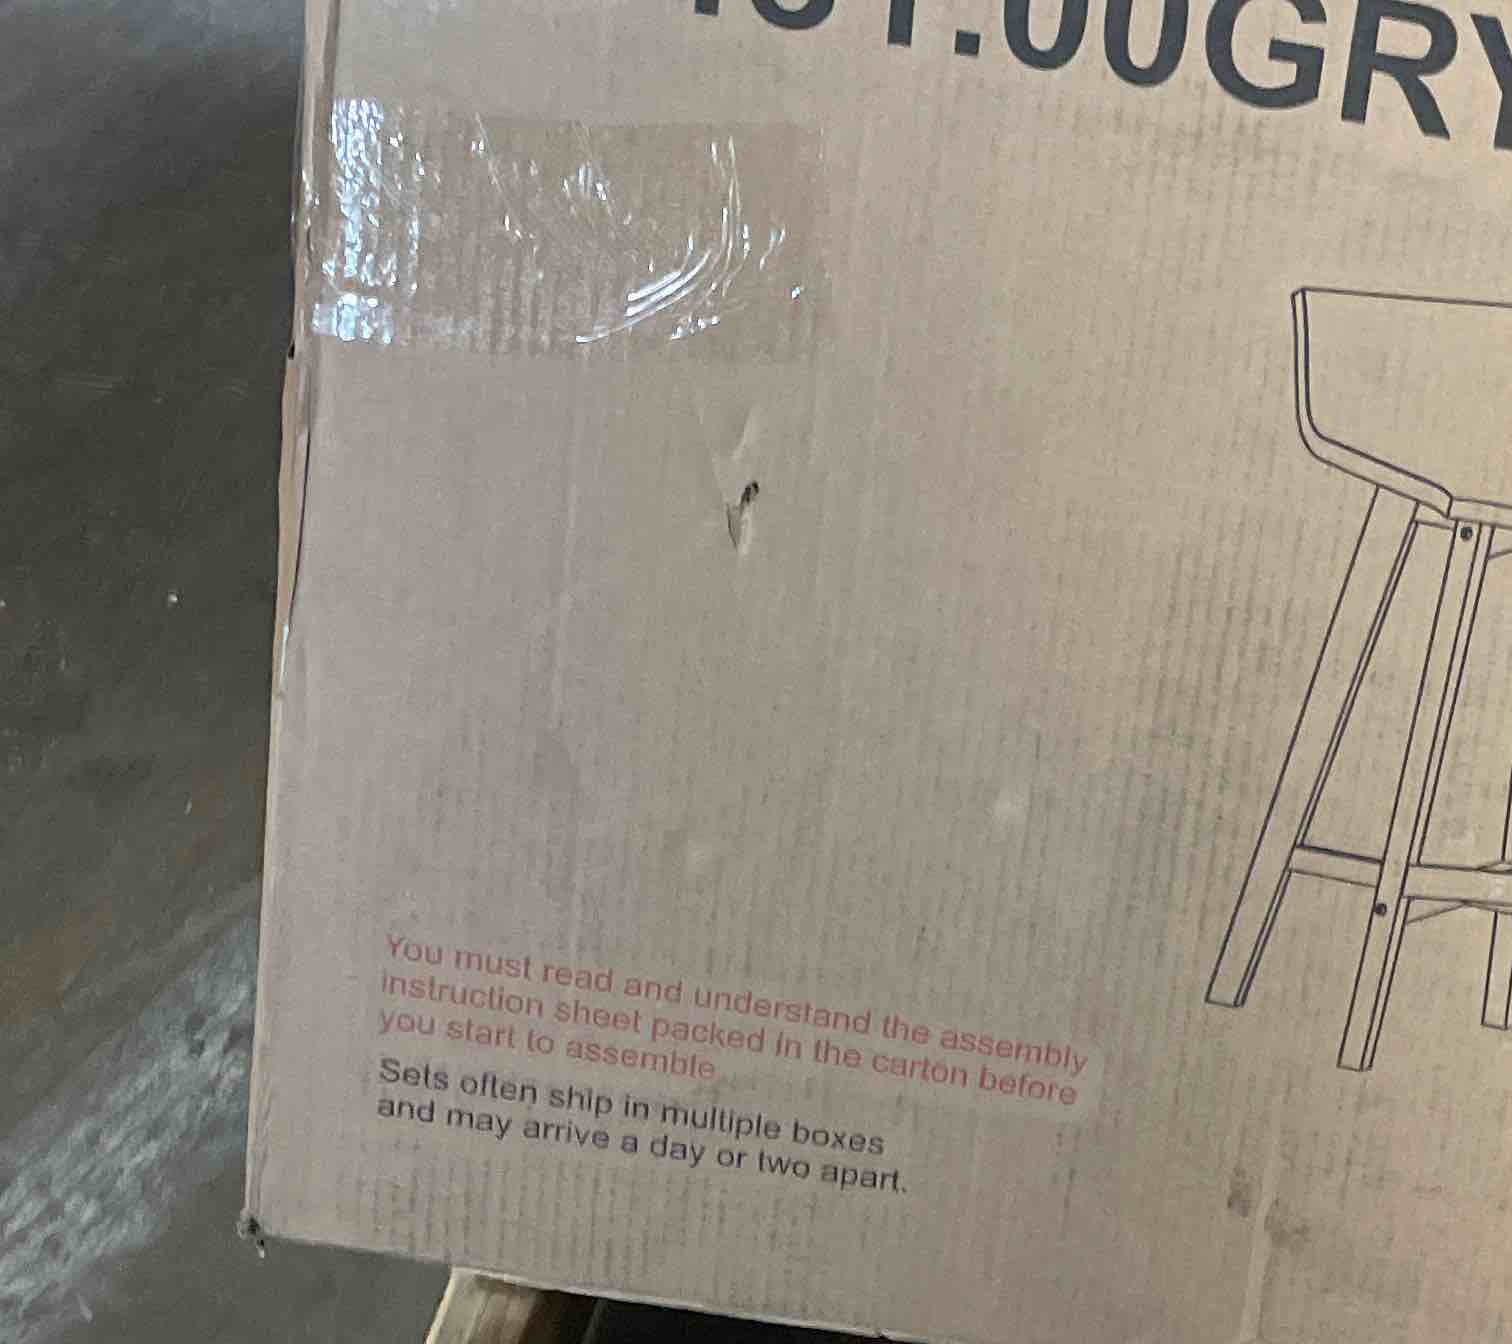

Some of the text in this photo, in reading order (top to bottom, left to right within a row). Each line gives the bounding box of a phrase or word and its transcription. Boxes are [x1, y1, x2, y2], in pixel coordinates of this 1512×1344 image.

[377, 1007, 717, 1081] you start to assemble
[385, 932, 1089, 1078] You must read and understand the assembly
[554, 997, 644, 1035] sheet
[649, 1016, 767, 1055] packed
[775, 1030, 802, 1060] in
[813, 1036, 864, 1069] the
[870, 1049, 969, 1089] carton
[978, 1064, 1078, 1106] before
[376, 1096, 908, 1195] and may arrive a day or two apart.
[378, 1056, 885, 1156] Sets often ship in multiple boxes
